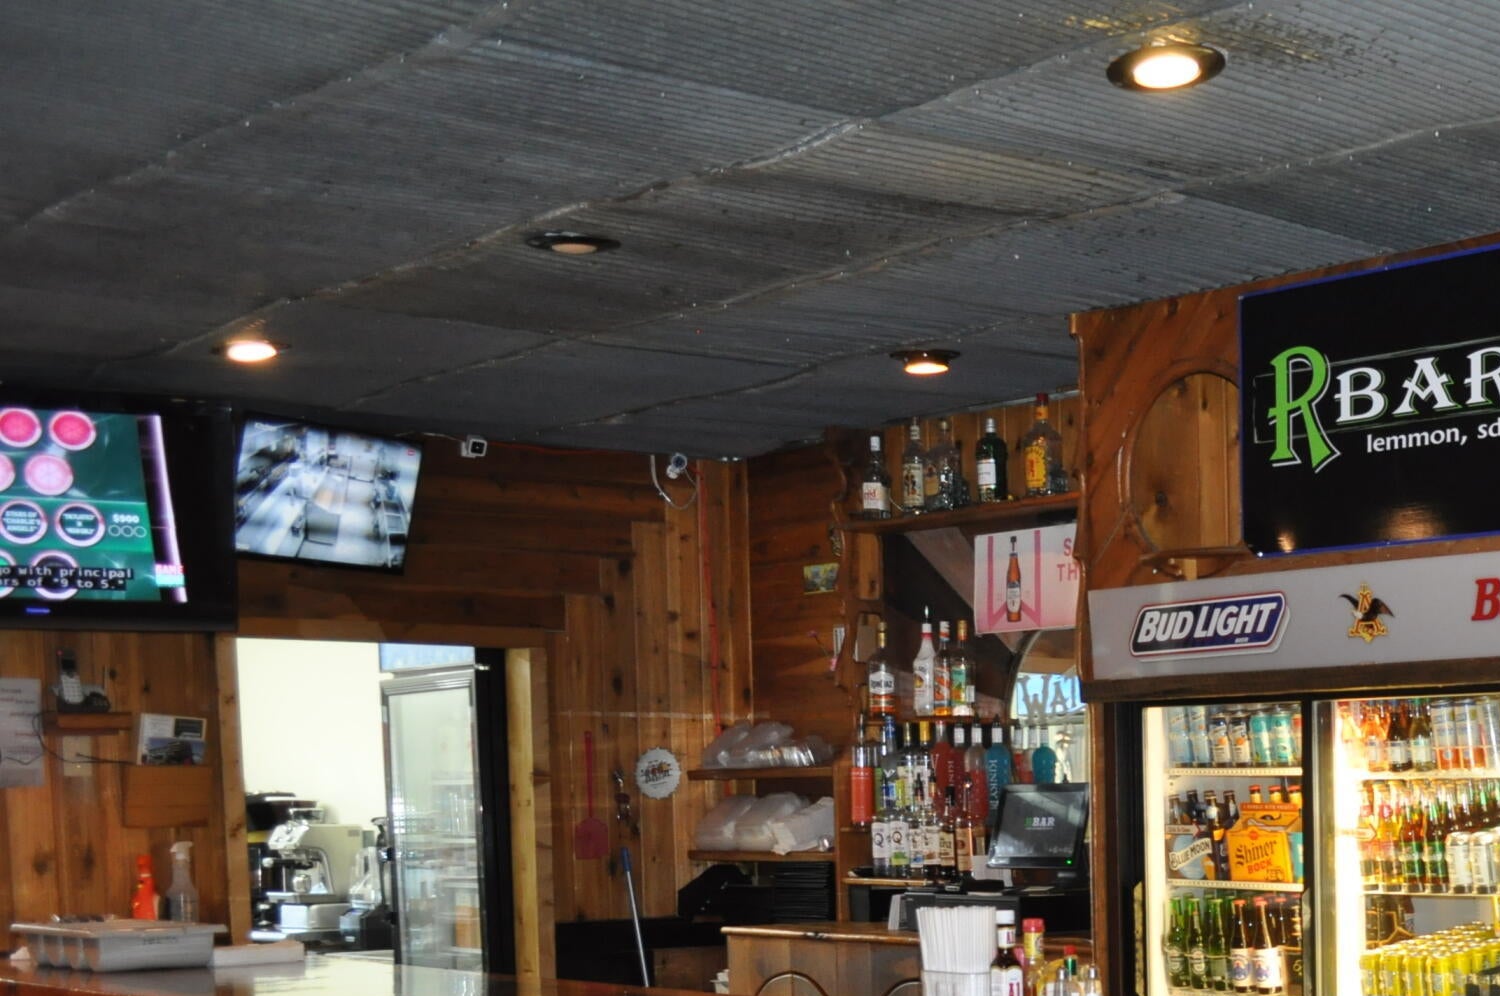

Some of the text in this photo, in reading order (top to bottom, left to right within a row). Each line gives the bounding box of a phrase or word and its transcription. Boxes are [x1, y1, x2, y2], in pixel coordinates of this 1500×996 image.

[1267, 346, 1340, 473] R
[1367, 427, 1468, 452] lemmon,
[18, 565, 52, 575] with
[59, 567, 132, 579] principal
[27, 577, 42, 587] of
[77, 579, 94, 589] to
[1137, 602, 1278, 643] BUD LIGHT
[1235, 840, 1277, 867] Shiner
